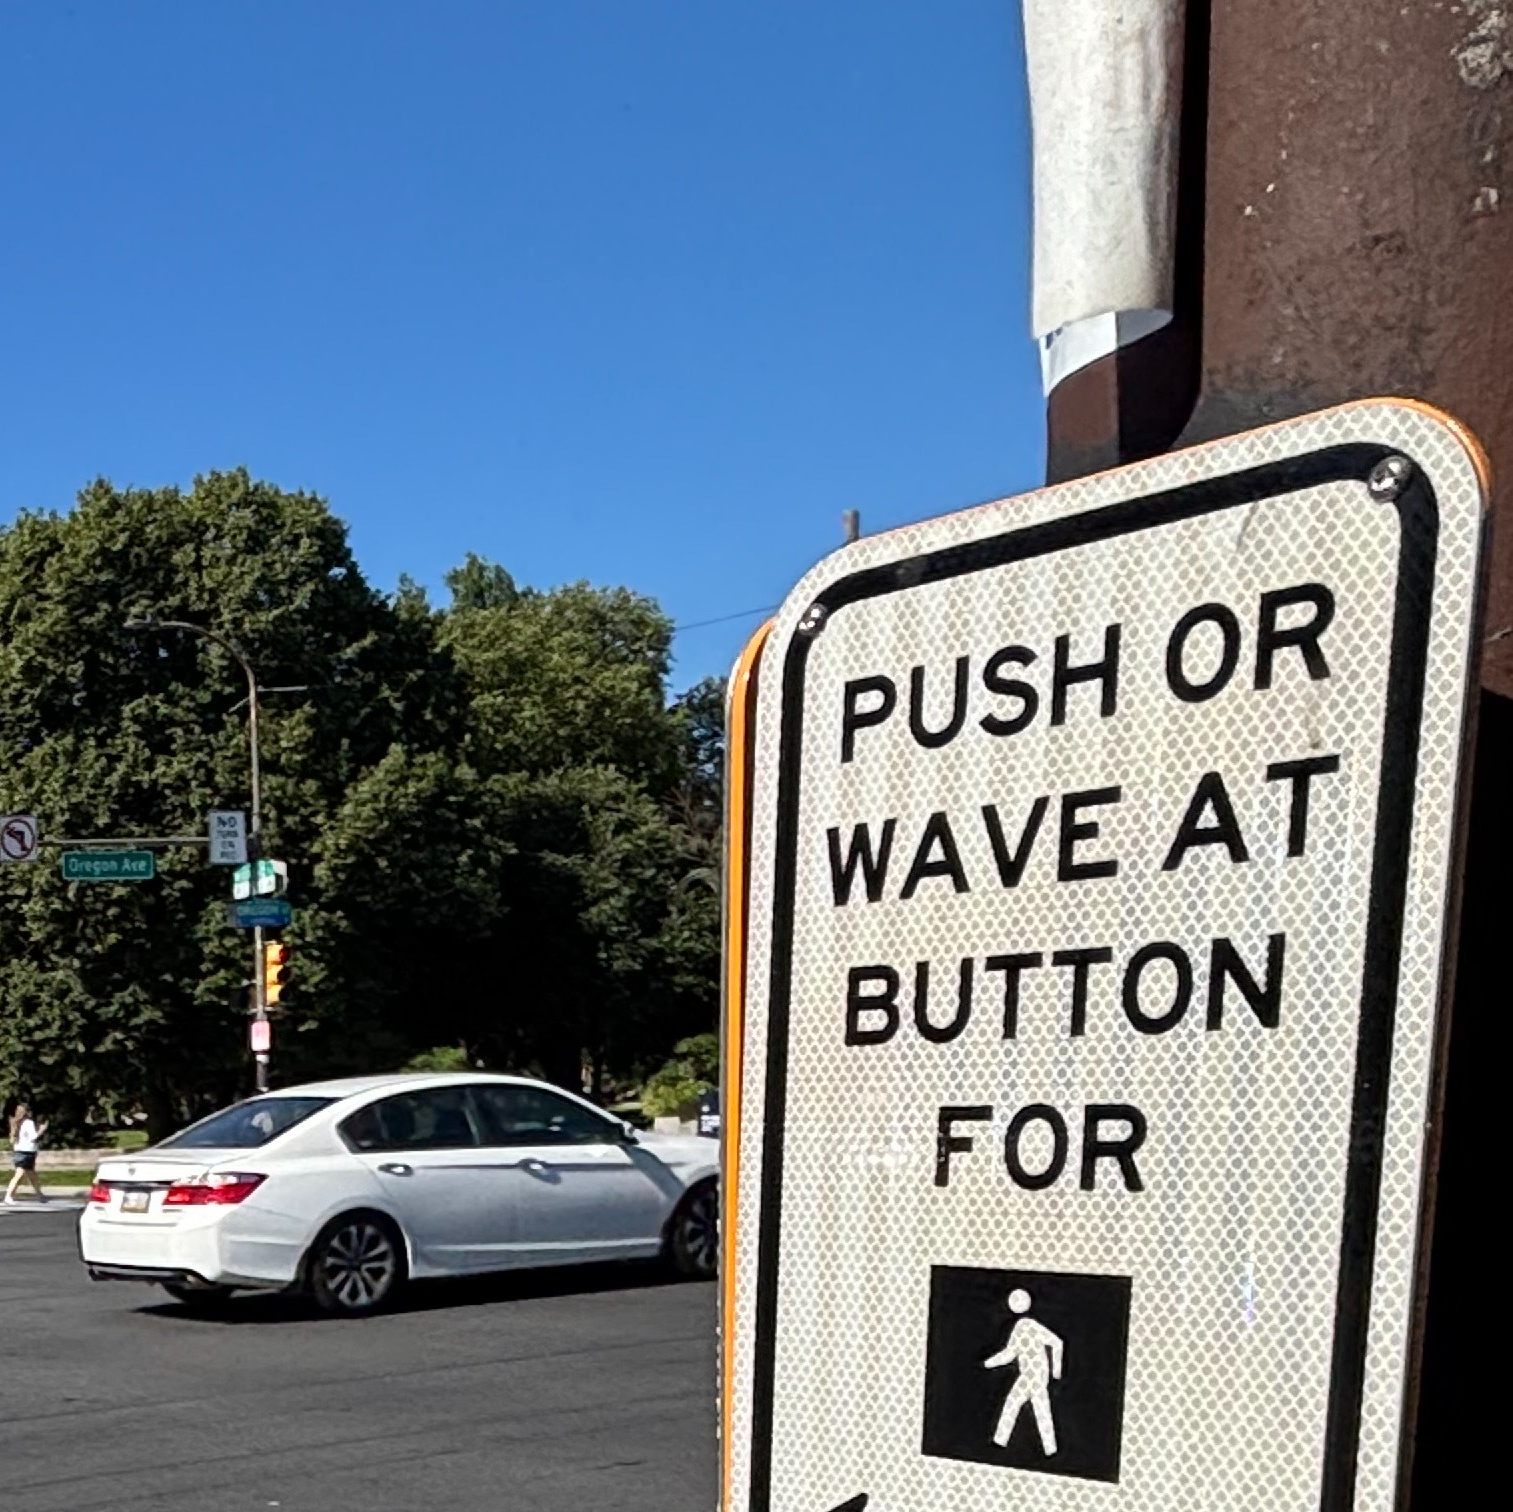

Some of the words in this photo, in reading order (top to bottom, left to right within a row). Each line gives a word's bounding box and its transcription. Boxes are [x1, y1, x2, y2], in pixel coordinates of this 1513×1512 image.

[840, 623, 1121, 764] PUSH
[1166, 583, 1335, 704] OR
[69, 858, 118, 876] Oregon
[122, 858, 147, 872] Ave
[217, 816, 238, 828] NO
[827, 786, 1121, 907] WAVE
[1162, 755, 1339, 872] AT
[845, 932, 1286, 1047] BUTTON
[934, 1102, 1148, 1193] FOR
